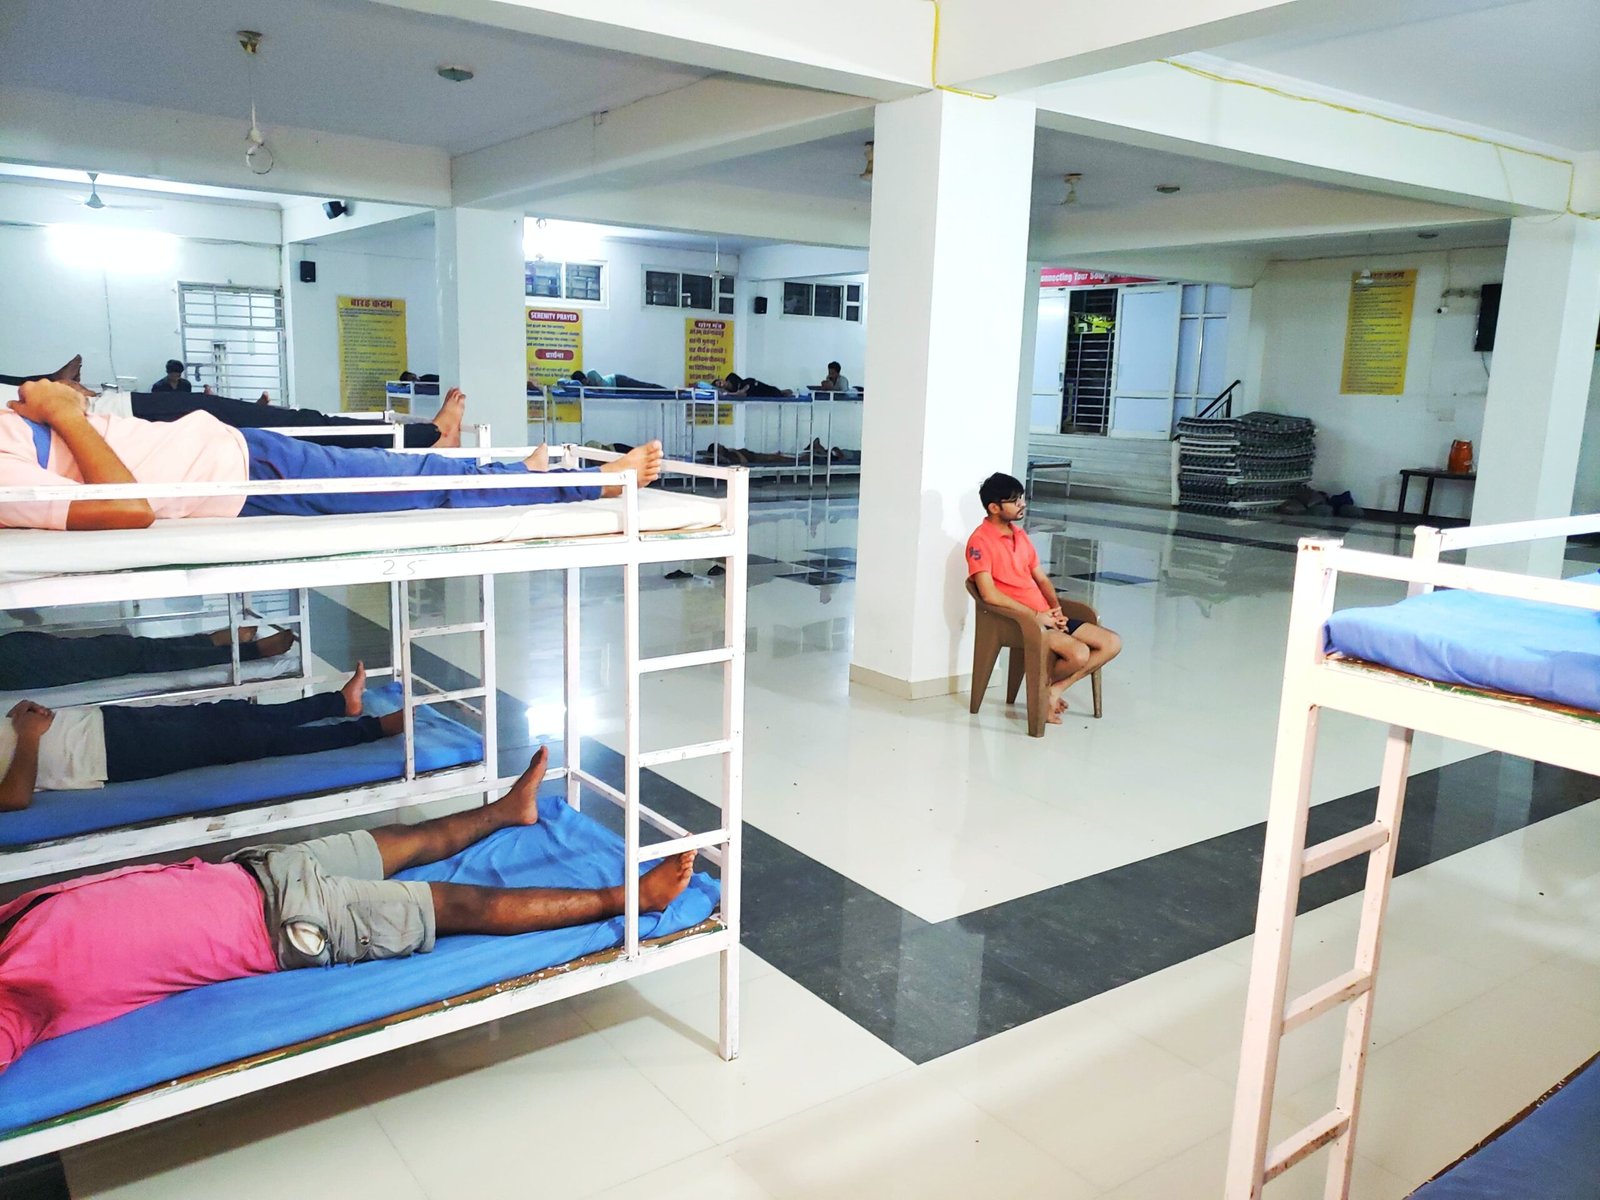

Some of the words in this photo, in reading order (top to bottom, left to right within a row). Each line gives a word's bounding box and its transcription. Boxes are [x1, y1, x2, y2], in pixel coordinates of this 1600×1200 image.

[1074, 272, 1088, 280] Your
[350, 298, 370, 307] बारह
[372, 299, 393, 308] कदम
[530, 311, 556, 320] SERENITY
[556, 313, 577, 321] PRAYER
[382, 559, 427, 576] 25
